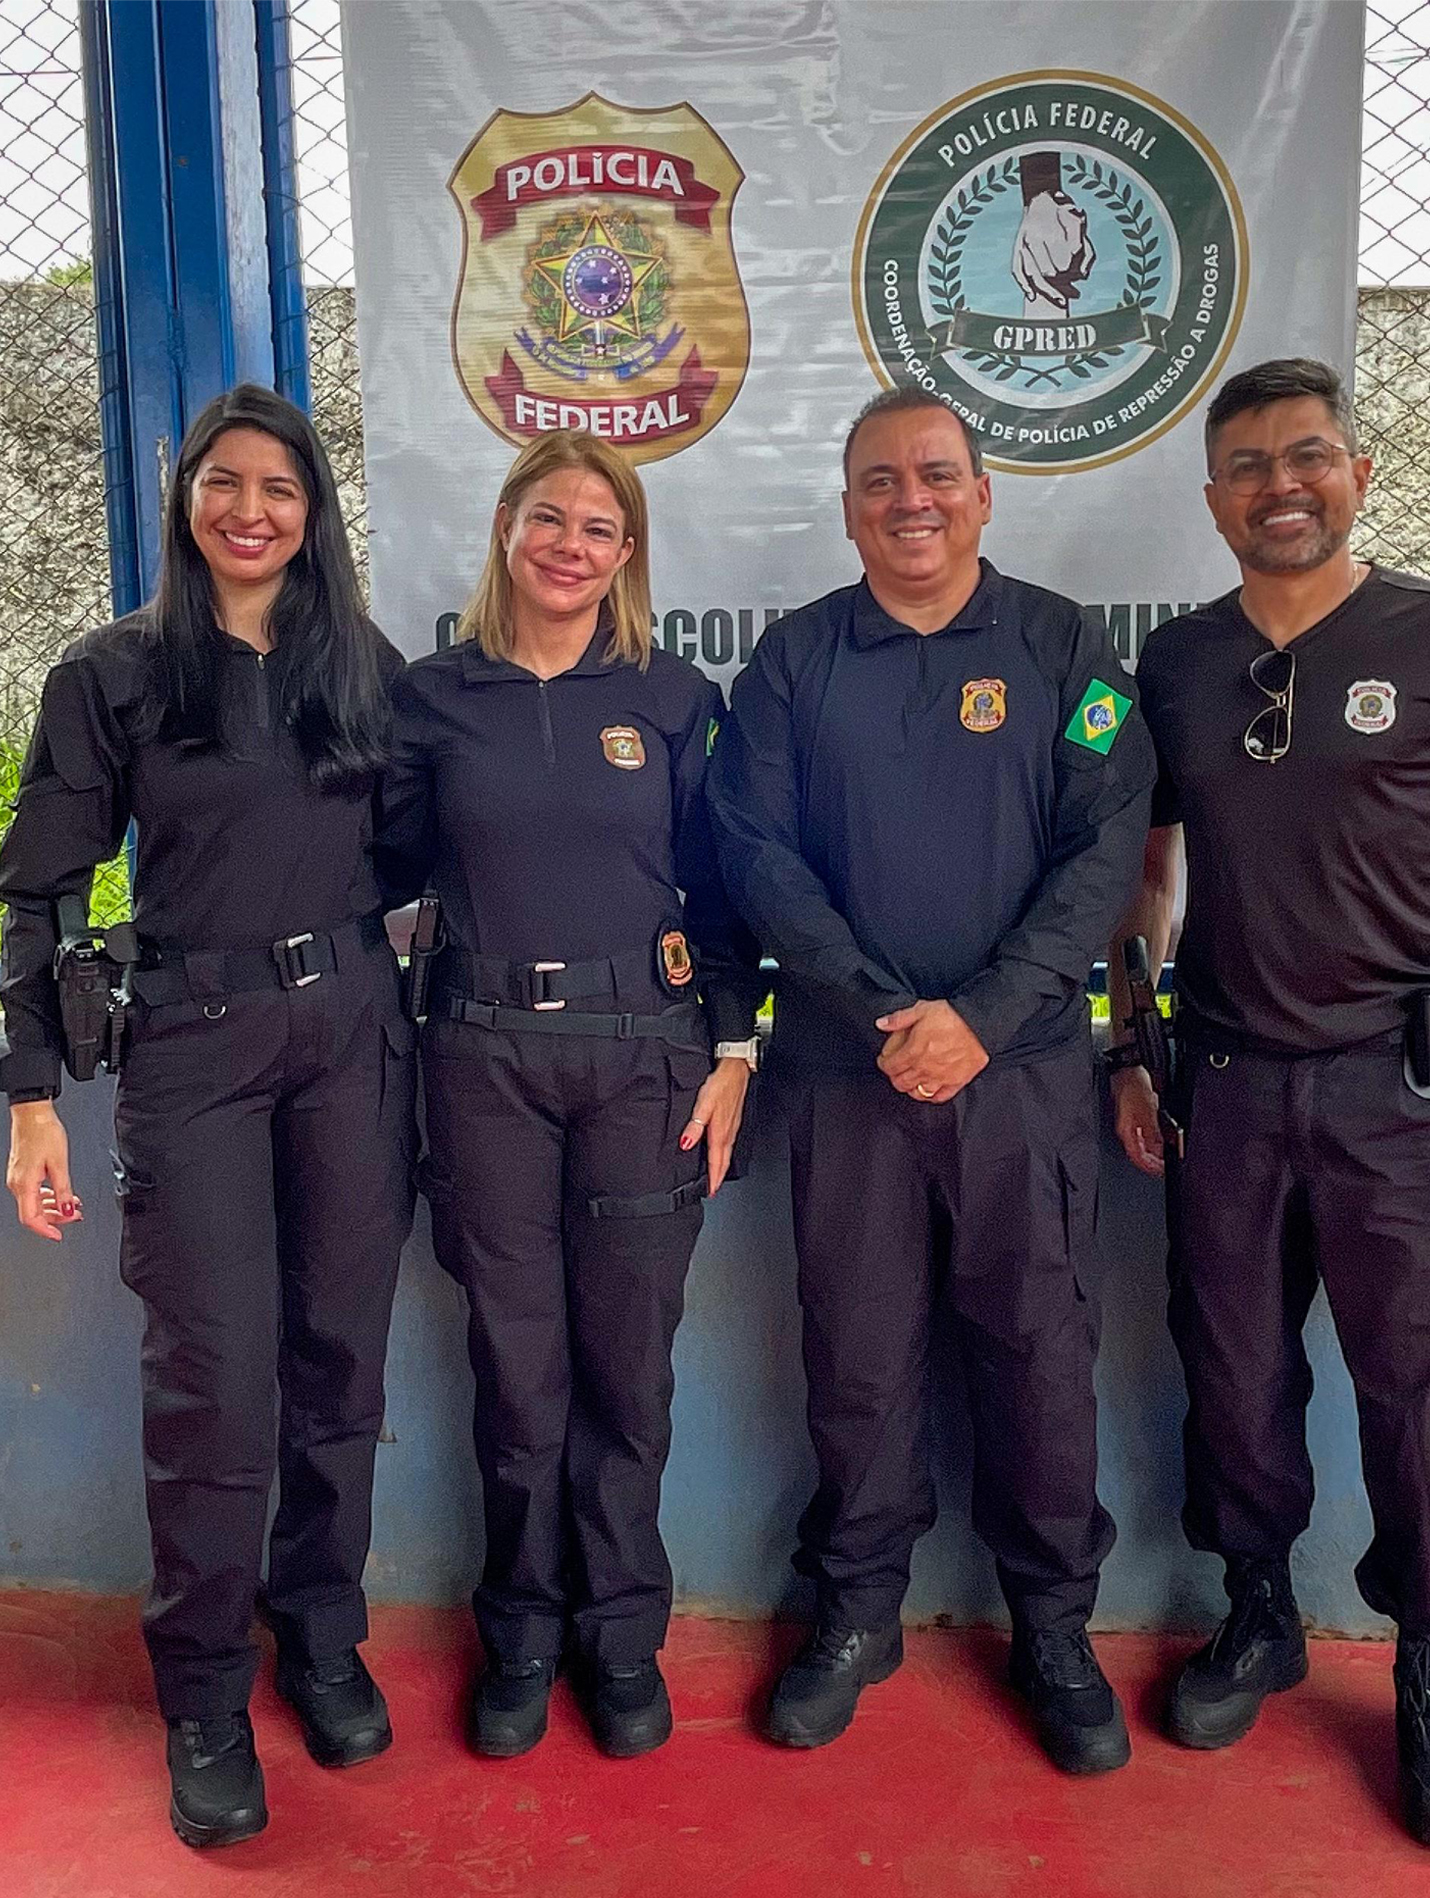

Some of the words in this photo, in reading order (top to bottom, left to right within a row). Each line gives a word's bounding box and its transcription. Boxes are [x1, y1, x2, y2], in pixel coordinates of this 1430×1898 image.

[938, 104, 1039, 168] POLÍCIA
[1050, 102, 1158, 161] FEDERAL
[1196, 243, 1219, 324] DROGAS
[993, 323, 1097, 352] GPRED
[1190, 328, 1206, 343] A
[1118, 344, 1196, 423] REPRESSÃO
[514, 394, 690, 438] FEDERAL
[1092, 415, 1118, 435] DE
[990, 422, 1015, 441] DE
[1018, 425, 1090, 444] POLÍCIA
